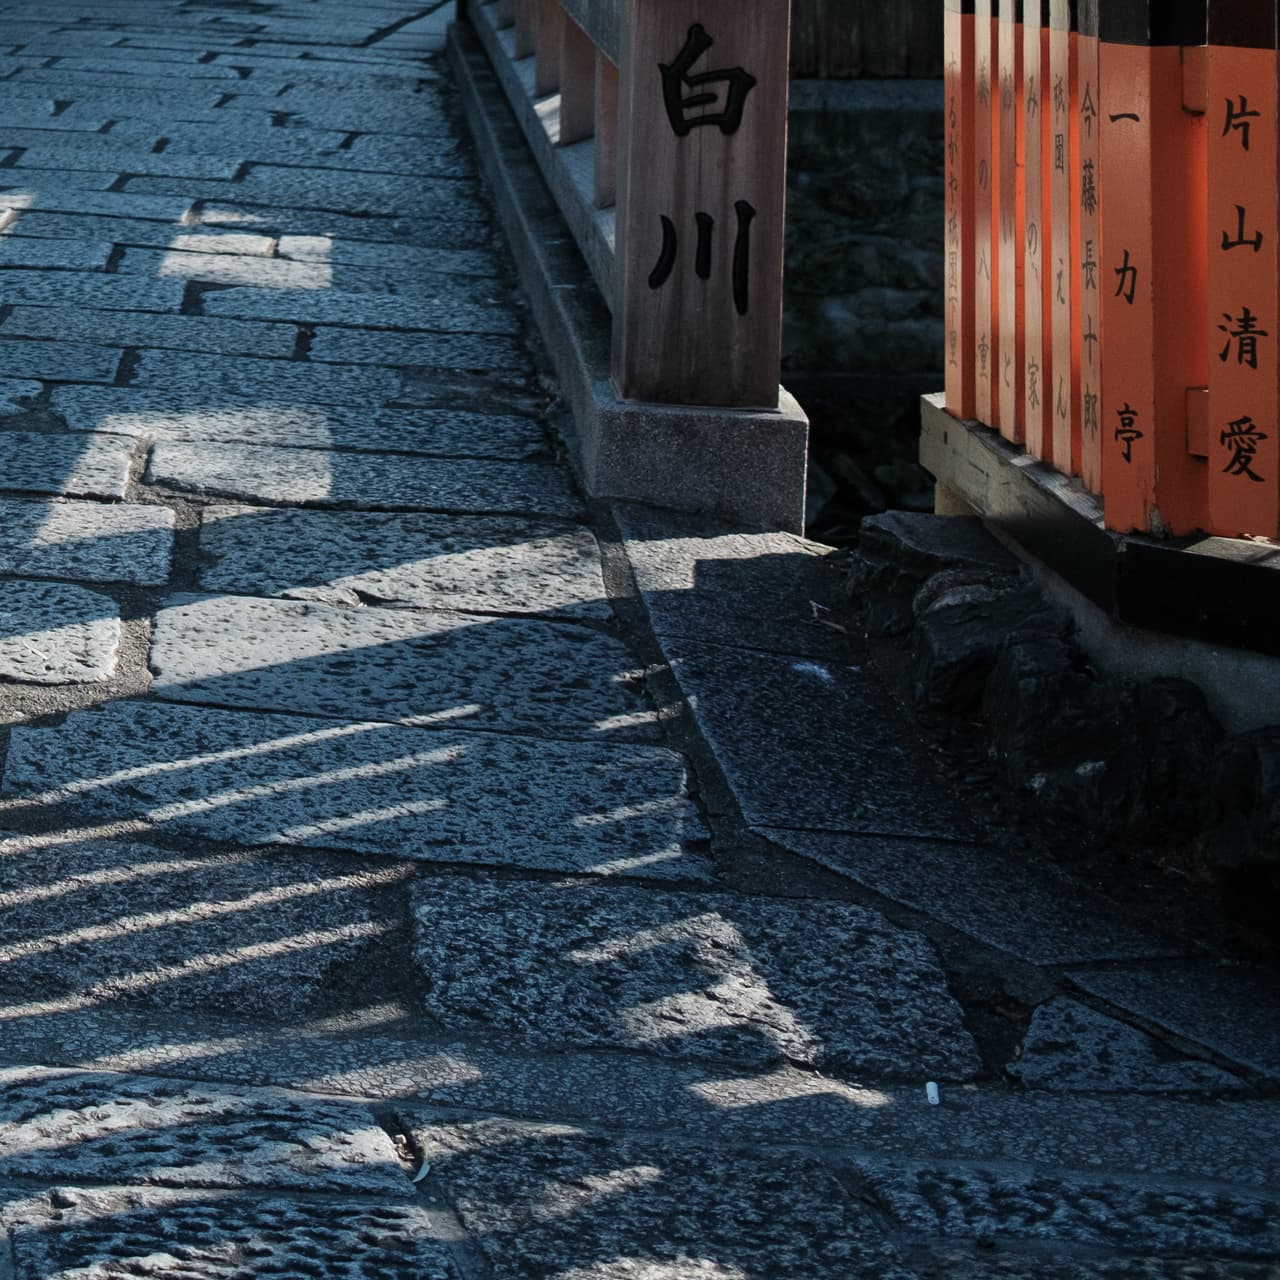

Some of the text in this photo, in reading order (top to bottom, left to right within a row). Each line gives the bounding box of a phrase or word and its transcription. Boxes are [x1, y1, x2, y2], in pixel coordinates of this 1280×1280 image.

[647, 22, 758, 316] 白川
[1081, 81, 1097, 442] 今藤長十郎
[1108, 110, 1144, 465] 一力亭
[1216, 93, 1269, 484] 片山清愛
